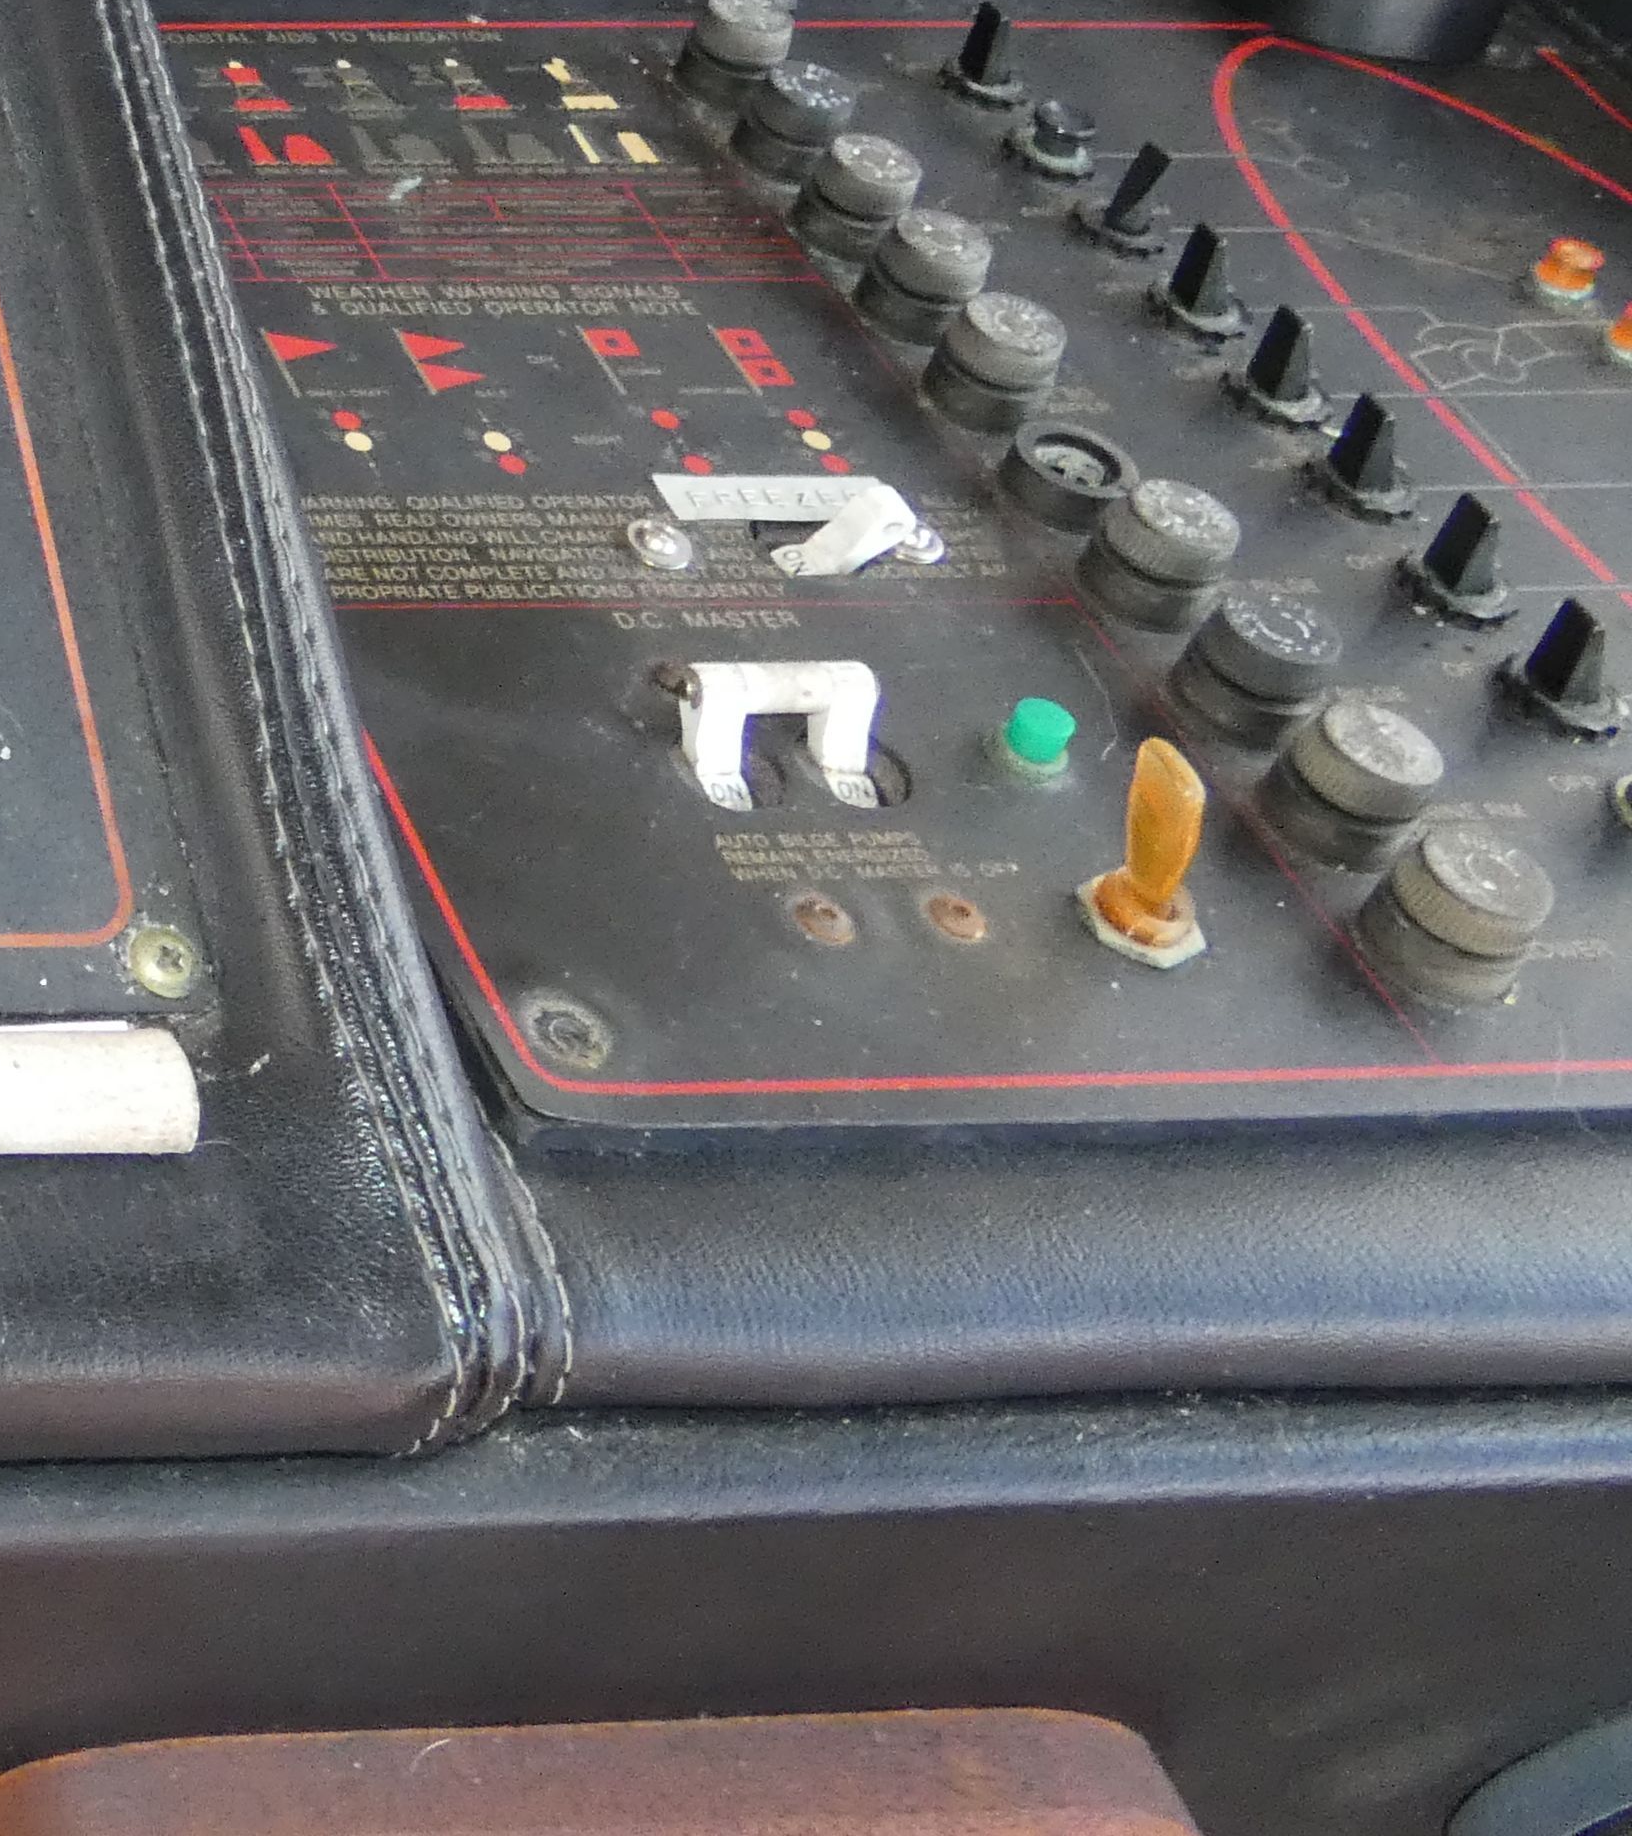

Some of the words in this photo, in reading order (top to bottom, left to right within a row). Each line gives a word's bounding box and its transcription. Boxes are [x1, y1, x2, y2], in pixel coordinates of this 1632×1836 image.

[306, 285, 431, 300] WEATHER
[437, 285, 560, 300] WARNING
[339, 301, 472, 316] QUALIFIED
[484, 301, 619, 316] OPERATOR
[405, 495, 524, 511] QUALIFIED
[680, 610, 801, 629] MASTER
